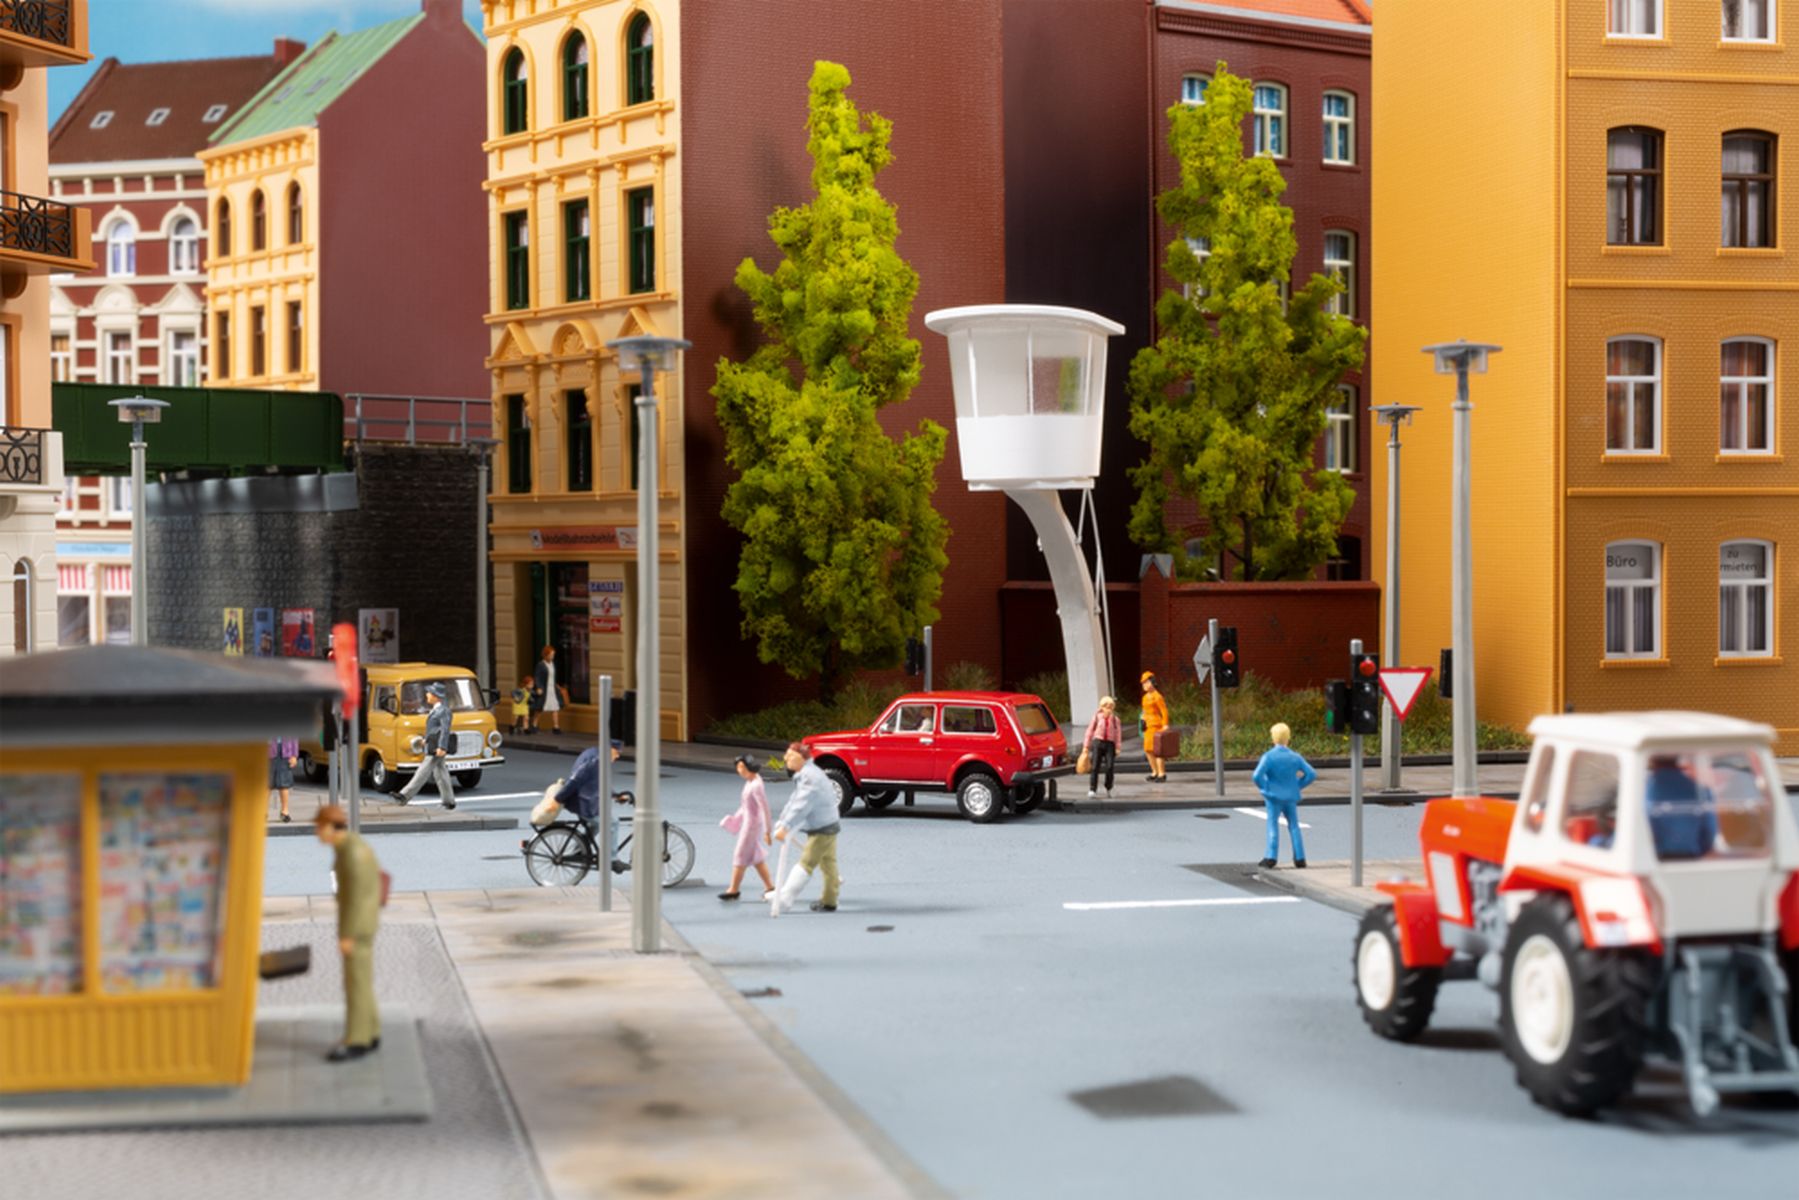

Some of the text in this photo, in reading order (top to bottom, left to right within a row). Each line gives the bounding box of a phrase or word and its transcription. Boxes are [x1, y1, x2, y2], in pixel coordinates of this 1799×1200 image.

[1726, 551, 1739, 559] zu
[1606, 555, 1637, 568] Büro
[1720, 562, 1757, 571] rmieten
